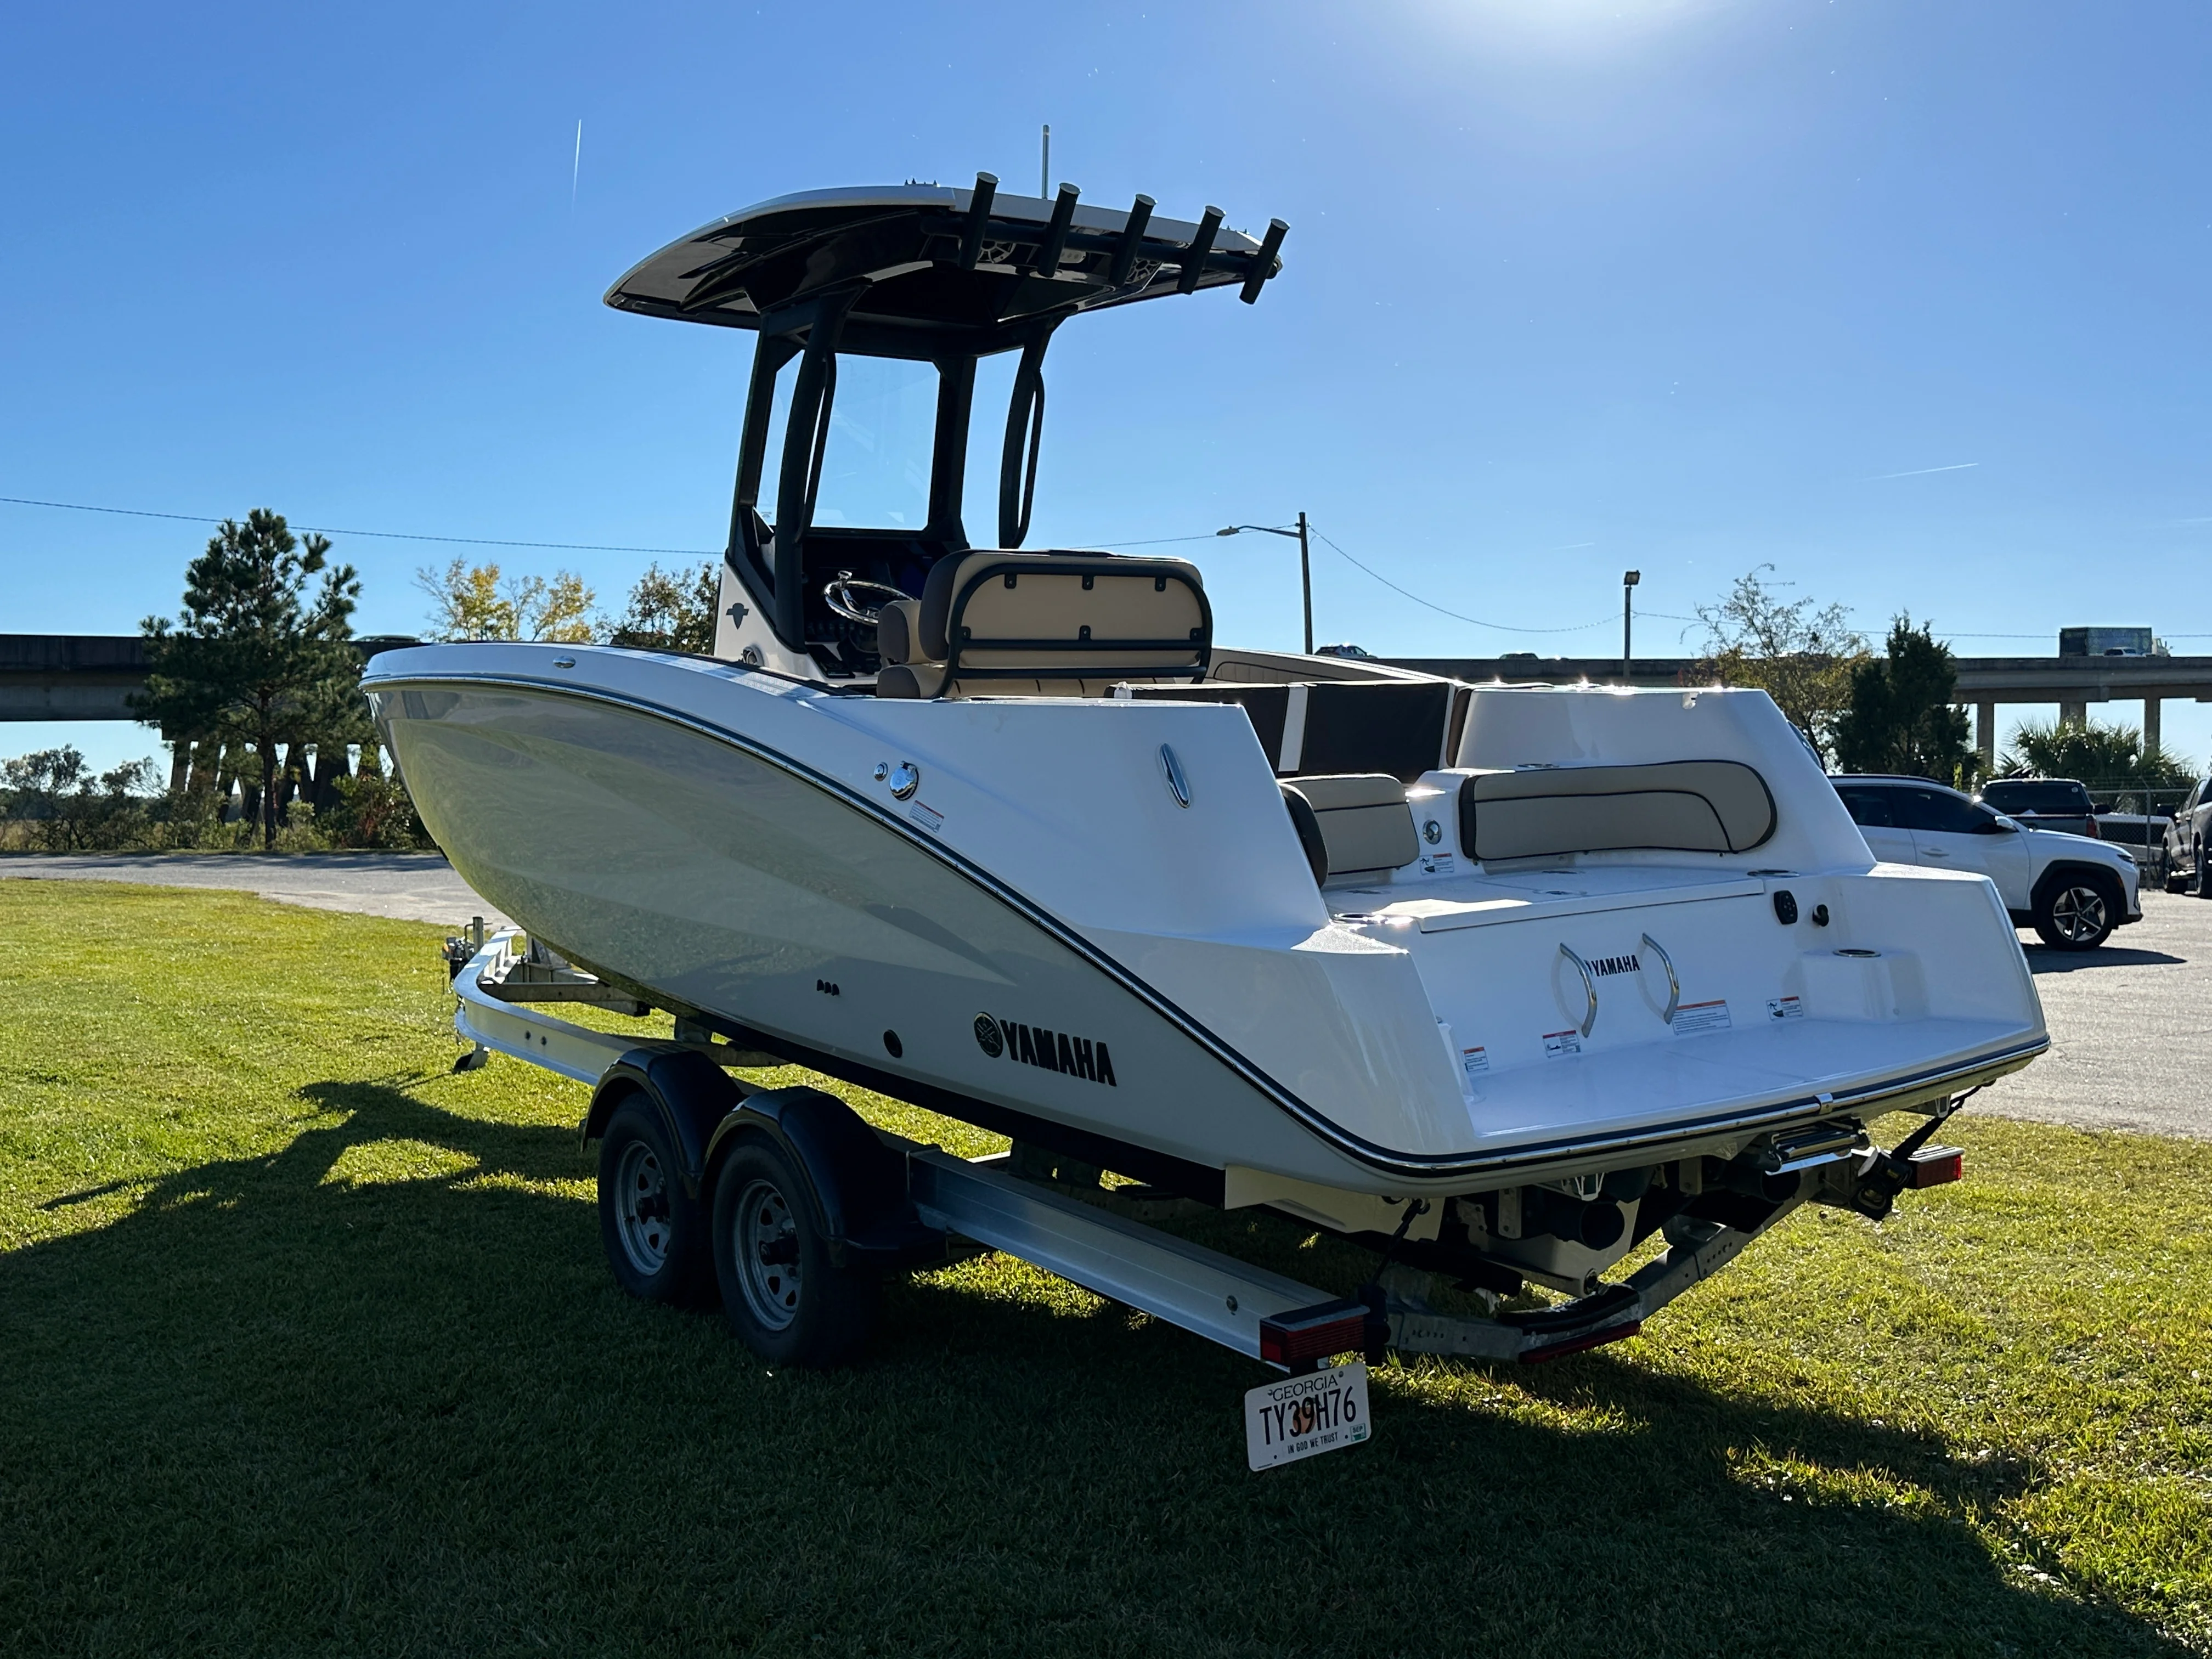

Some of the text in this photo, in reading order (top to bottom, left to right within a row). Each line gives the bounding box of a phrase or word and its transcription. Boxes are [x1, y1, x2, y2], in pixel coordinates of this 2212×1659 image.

[1591, 955, 1640, 977] YAMAHA
[1000, 1019, 1117, 1087] YAMAHA
[1273, 1374, 1338, 1401] GEORGIA
[1259, 1385, 1356, 1445] TY39H76
[1287, 1431, 1338, 1454] IN GOD WE TRUST
